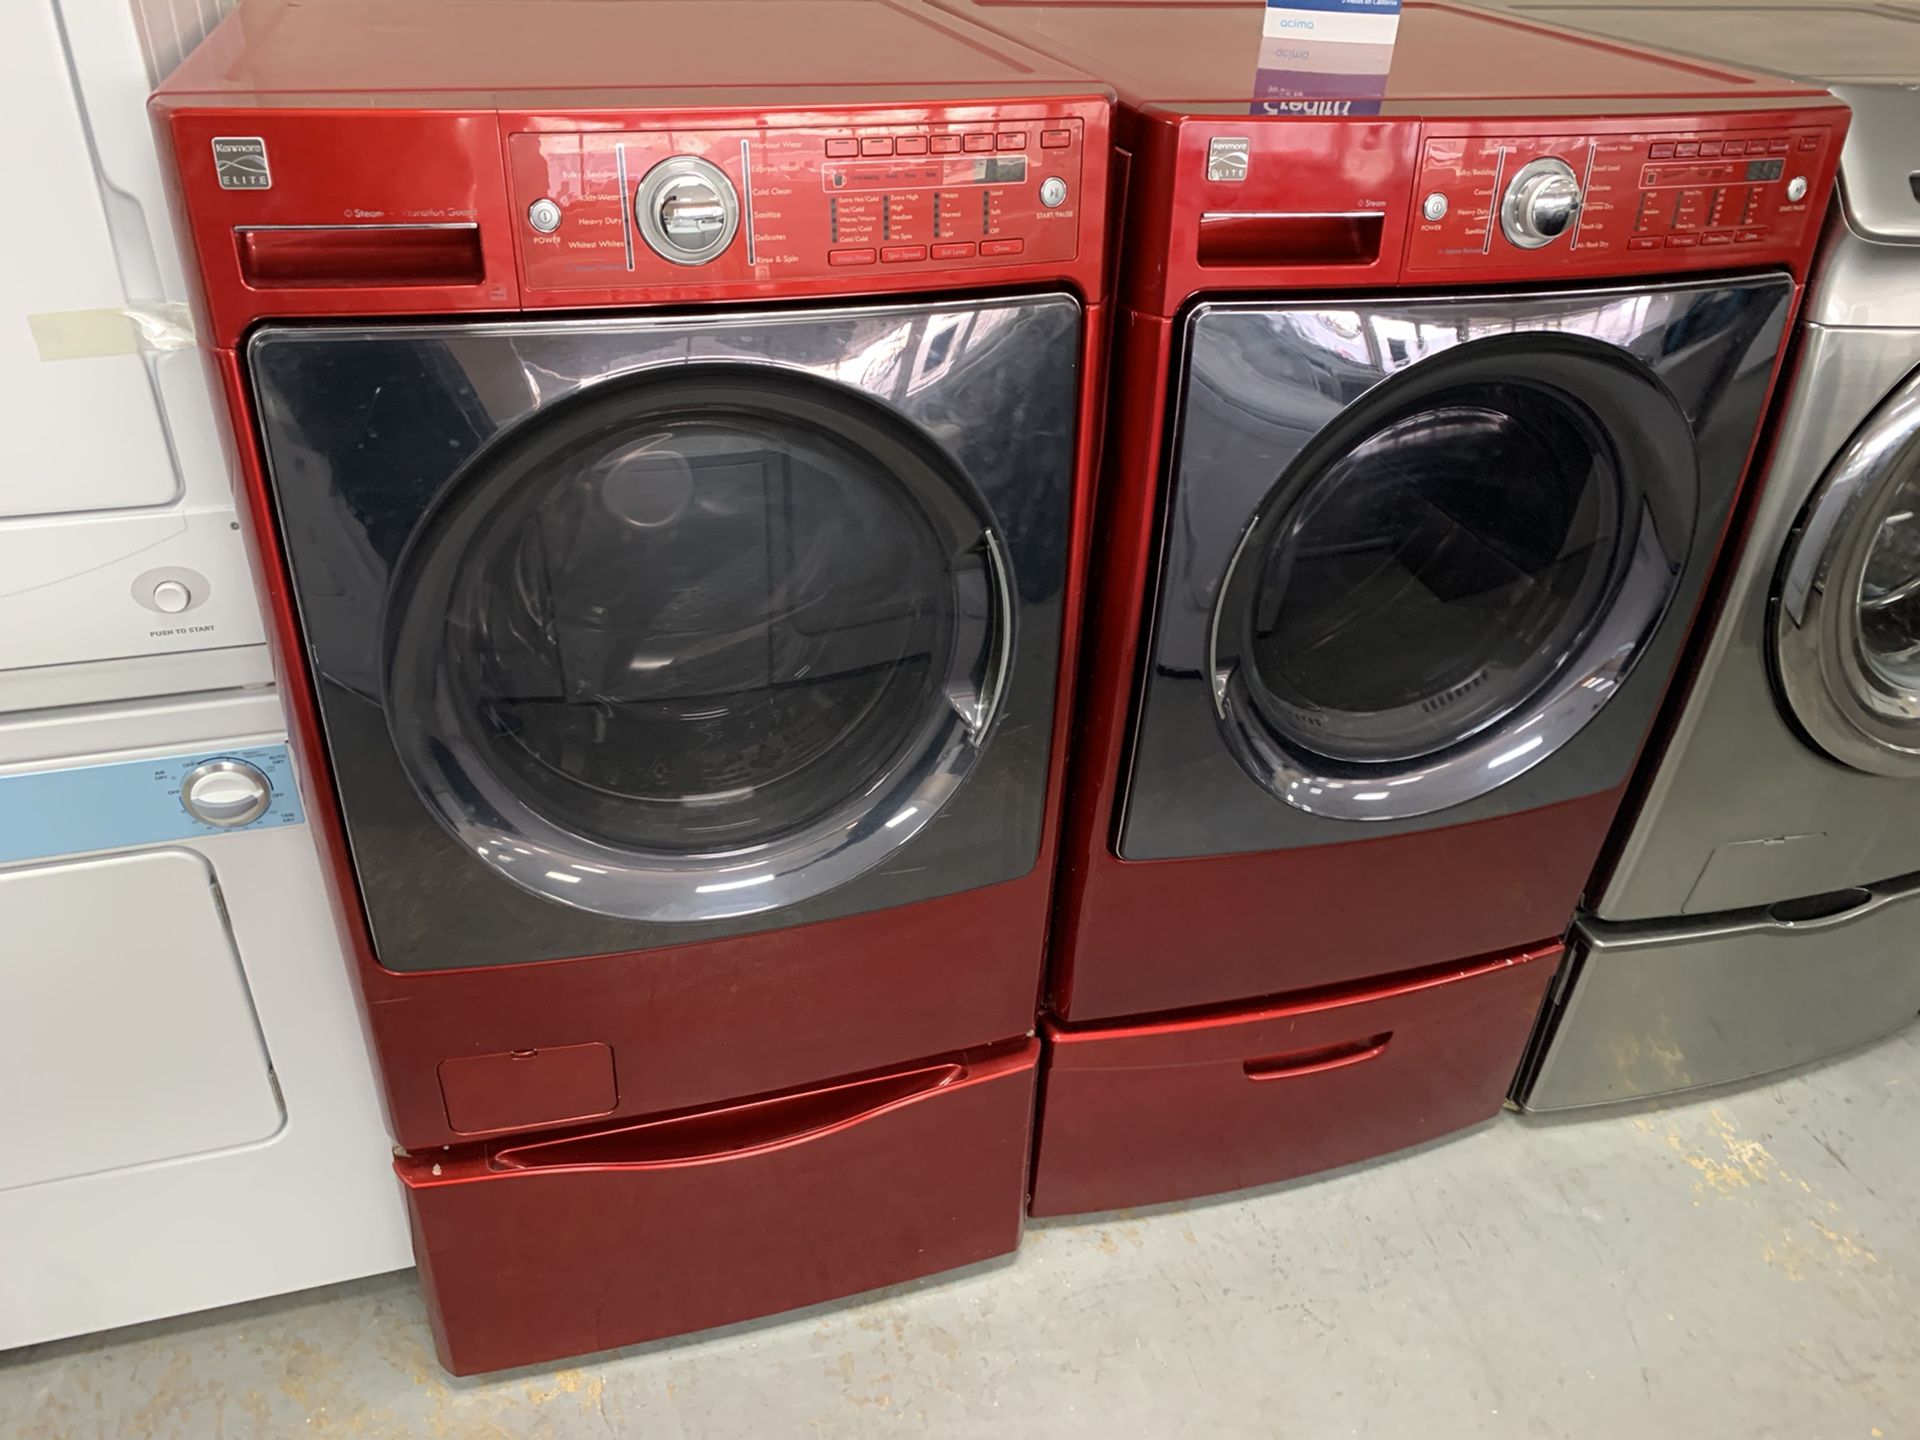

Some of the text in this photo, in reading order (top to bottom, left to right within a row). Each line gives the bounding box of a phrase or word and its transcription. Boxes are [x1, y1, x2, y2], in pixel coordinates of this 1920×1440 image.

[1280, 18, 1314, 30] acima
[215, 143, 262, 153] Kenmore
[1213, 142, 1248, 150] Kenmore
[1211, 169, 1245, 178] ELITE
[222, 175, 268, 185] ELITE
[752, 186, 792, 196] Cold Clean
[1365, 199, 1386, 207] Steam
[753, 210, 782, 219] Sanitize
[578, 216, 623, 226] Heavy Duty
[533, 236, 561, 245] POWER
[755, 233, 786, 242] Delicates
